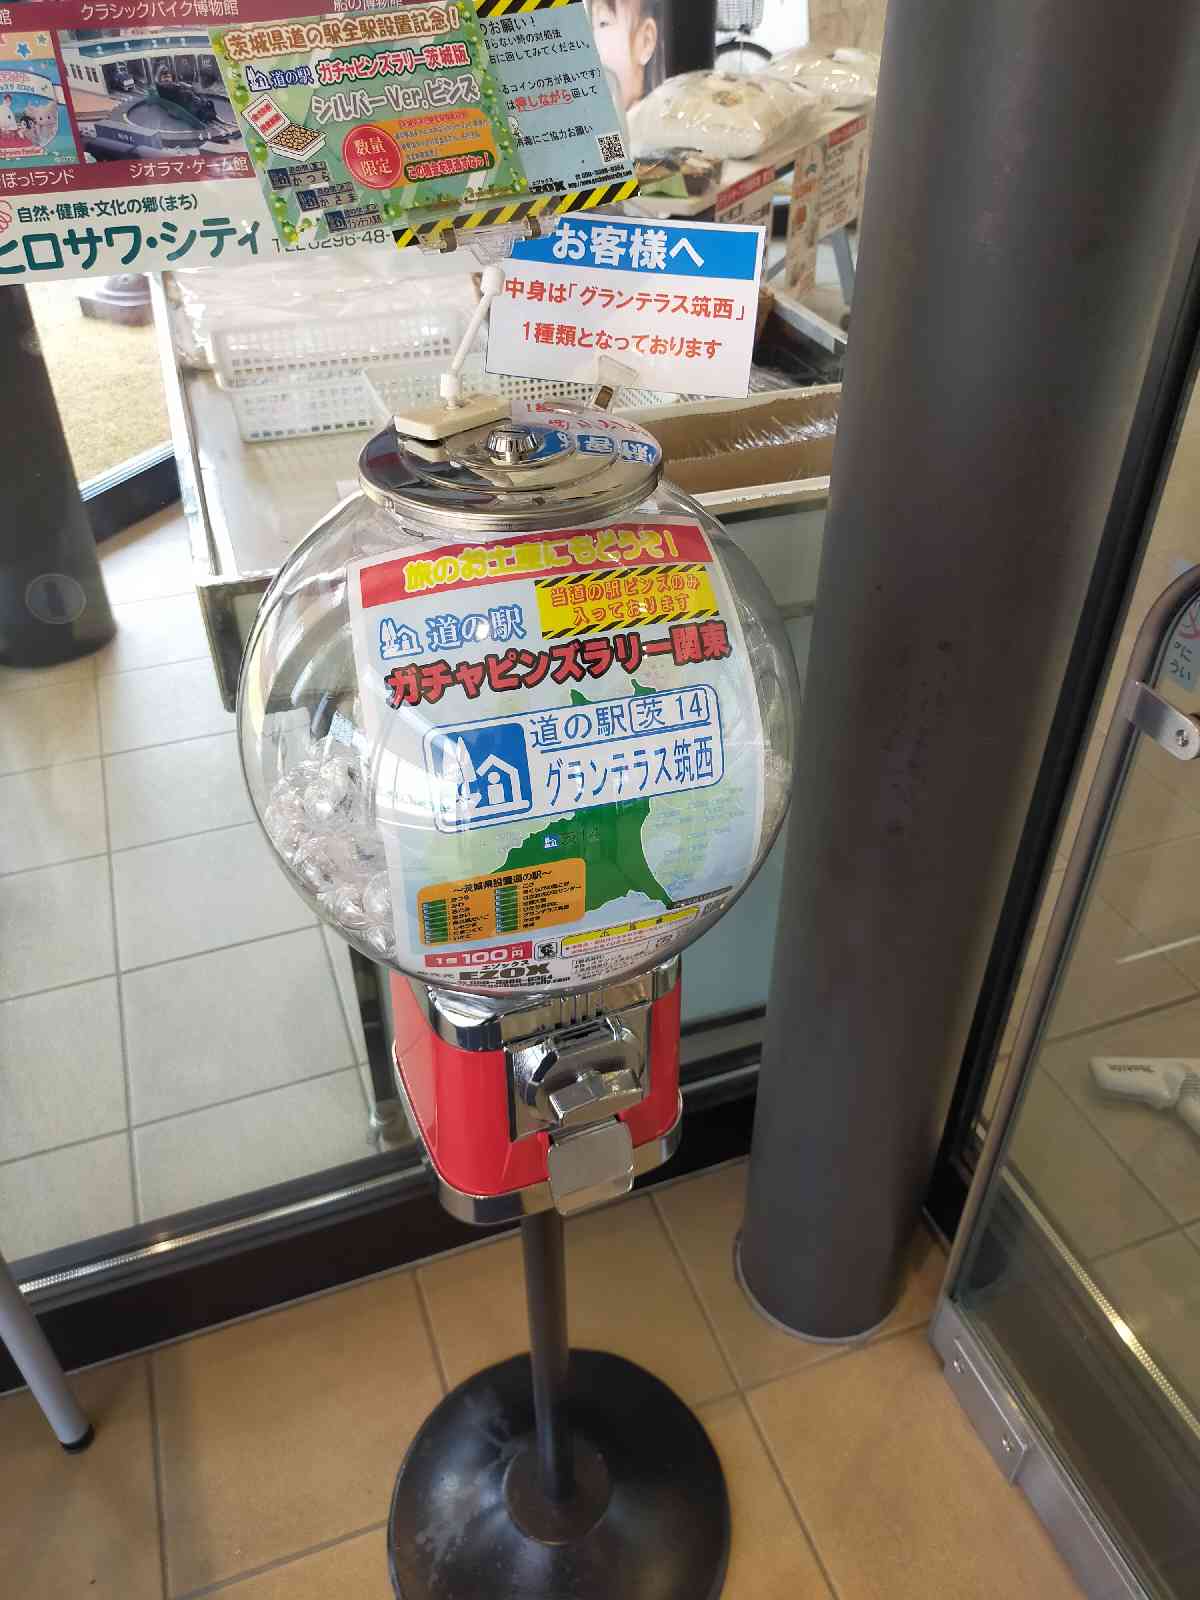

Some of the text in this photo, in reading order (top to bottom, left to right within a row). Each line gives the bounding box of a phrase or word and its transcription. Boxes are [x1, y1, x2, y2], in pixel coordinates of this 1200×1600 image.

[354, 137, 386, 156] 数量
[360, 158, 393, 178] 限定
[552, 222, 705, 270] お客様へ
[504, 277, 745, 321] 中身は「グランテラス筑西」
[521, 320, 723, 359] 1種類となっております
[427, 604, 528, 651] 道の駅
[572, 591, 690, 627] 入っております
[383, 620, 733, 709] ガチャピンズラリー関東
[529, 703, 626, 749] 道の駅
[675, 692, 703, 721] 14
[545, 735, 714, 806] グランテラス筑西
